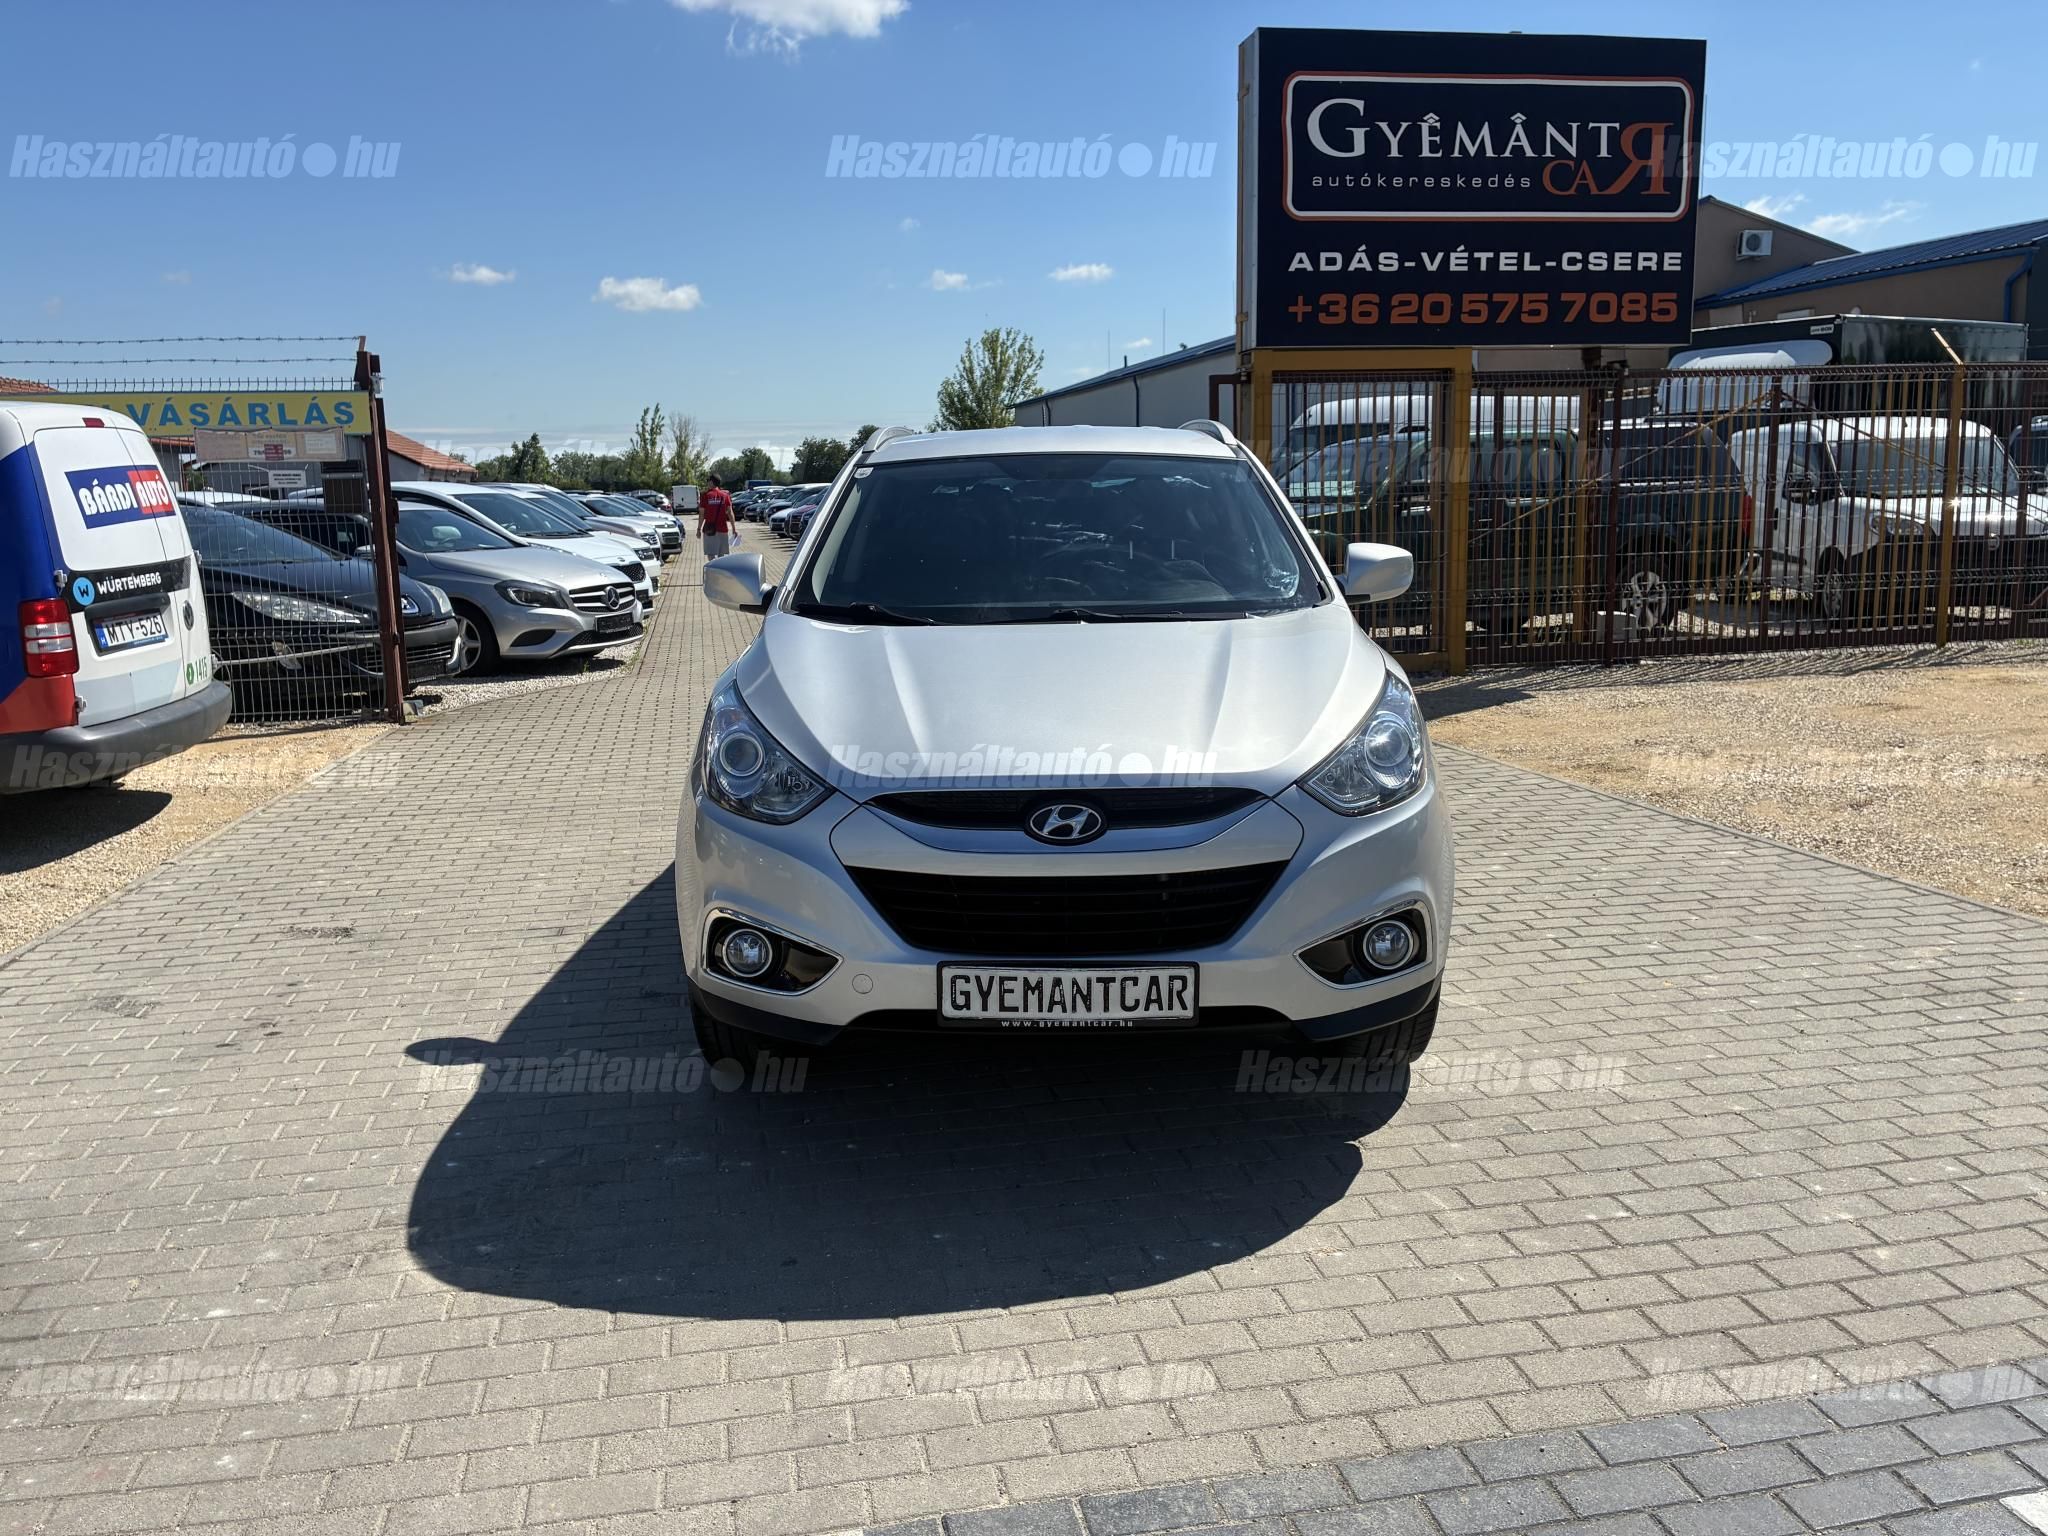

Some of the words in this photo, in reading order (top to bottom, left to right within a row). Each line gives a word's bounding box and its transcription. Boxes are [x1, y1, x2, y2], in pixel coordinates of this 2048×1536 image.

[1312, 172, 1532, 188] autókereskedés
[1288, 243, 1683, 272] ADÁS-VÉTEL-CSERE
[1288, 293, 1380, 324] +36
[1390, 293, 1452, 324] 20
[1460, 292, 1549, 324] 575
[1562, 292, 1678, 323] 7085
[101, 397, 355, 426] VÁSÁRLÁS
[78, 478, 138, 516] BÁRDI
[135, 474, 169, 508] AUTÓ
[97, 571, 162, 595] WÜRTEMBERG
[106, 615, 162, 644] MTY-526
[950, 974, 1188, 1013] GYEMANTCAR
[1001, 1020, 1133, 1028] www.gyemantcar.hu
